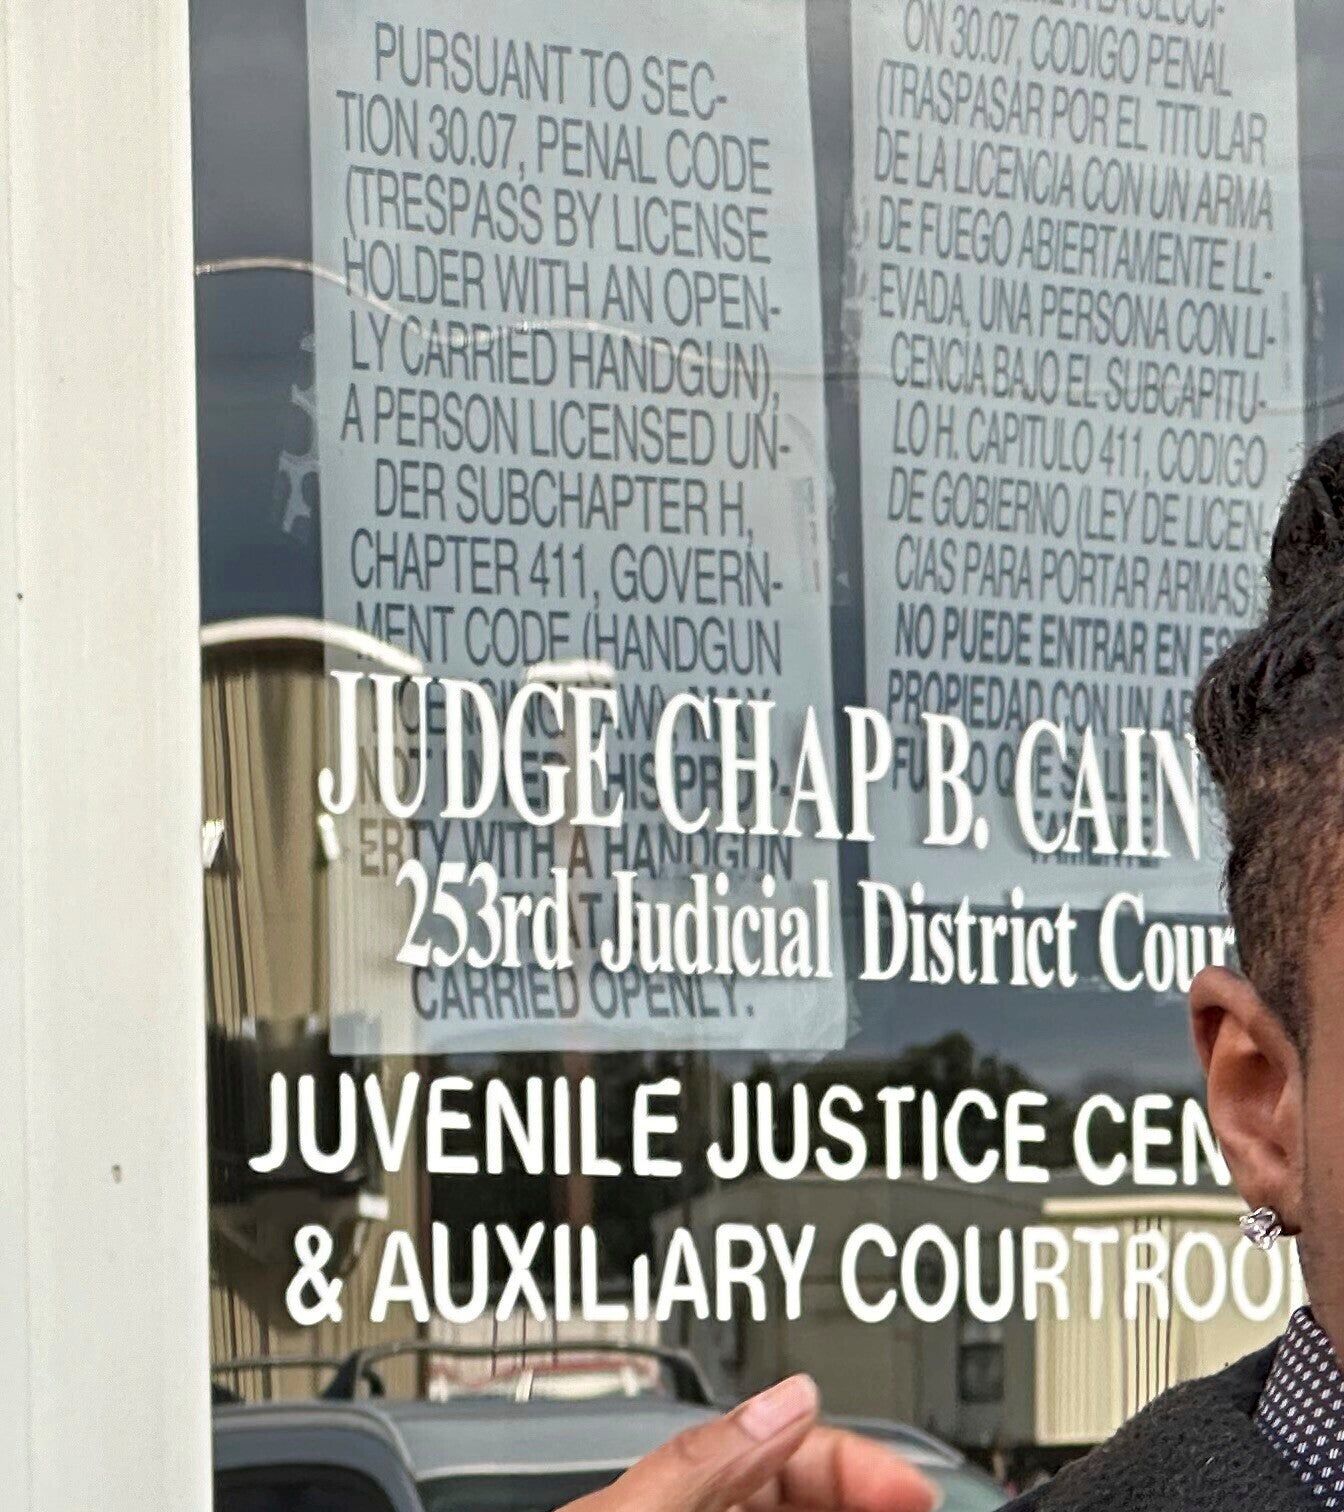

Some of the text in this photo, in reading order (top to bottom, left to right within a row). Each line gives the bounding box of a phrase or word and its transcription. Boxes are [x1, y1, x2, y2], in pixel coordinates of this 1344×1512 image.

[375, 21, 727, 121] PURSUANT TO SEC-
[905, 1, 944, 56] ON
[952, 7, 1020, 73] 30.07,
[1031, 17, 1140, 83] CODIGO
[1146, 31, 1232, 96] PENAL
[336, 90, 772, 194] TION 30.07, PENAL CODE
[877, 59, 1268, 166] (TRASPASAR POR EL TITULAR
[346, 165, 772, 263] (TRESPASS BY LICENSE
[874, 126, 1273, 231] DE LA LICENCIA CON UN ARMA
[343, 238, 781, 332] HOLDER WITH AN OPEN-
[878, 196, 1273, 295] DE FUEGO ABIERTAMENTE LL-
[878, 263, 1275, 361] EVADA, UNA PERSONA CON LI-
[351, 310, 780, 415] LY CARRIED HANDGUN),
[891, 332, 1267, 427] CENCIA BAJO EL SUBCAPITU-
[340, 383, 790, 471] A PERSON LICENSED UN-
[893, 400, 930, 458] LO
[966, 407, 1094, 474] CAPITULO
[1100, 420, 1149, 484] 411,
[1157, 425, 1267, 490] CODIGO
[374, 458, 753, 542] DER SUBCHAPTER H,
[889, 467, 923, 525] DE
[932, 471, 1071, 536] GOBIERNO
[1076, 484, 1135, 552] (LEY
[1142, 490, 1178, 544] DE
[351, 528, 782, 608] CHAPTER 411, GOVERN-
[896, 534, 955, 596] CIAS
[963, 540, 1034, 602] PARA
[1041, 546, 1149, 611] PORTAR
[356, 602, 782, 676] MENT CODE (HANDGUN
[895, 602, 933, 660] NO
[942, 606, 1032, 667] PUEDE
[1040, 613, 1149, 675] ENTRAR
[1157, 622, 1191, 678] EN
[888, 669, 1194, 738] PROPIEDAD CON UN AR
[318, 670, 624, 828] JUDGE
[656, 693, 893, 842] CHAP
[920, 711, 989, 849] B.
[1015, 718, 1202, 860] CAIN
[462, 820, 555, 878] WITH
[568, 823, 593, 878] A
[606, 823, 793, 881] HANDGUN
[396, 859, 574, 970] 253rd
[600, 871, 833, 978] Judicial
[858, 879, 1077, 988] District
[1099, 892, 1234, 992] Cour
[412, 961, 754, 1020] CARRIED OPENLY.
[249, 1072, 1231, 1187] JUVENILE JUSTICE CEN
[284, 1222, 1309, 1327] & AUXILIARY COURTROO
